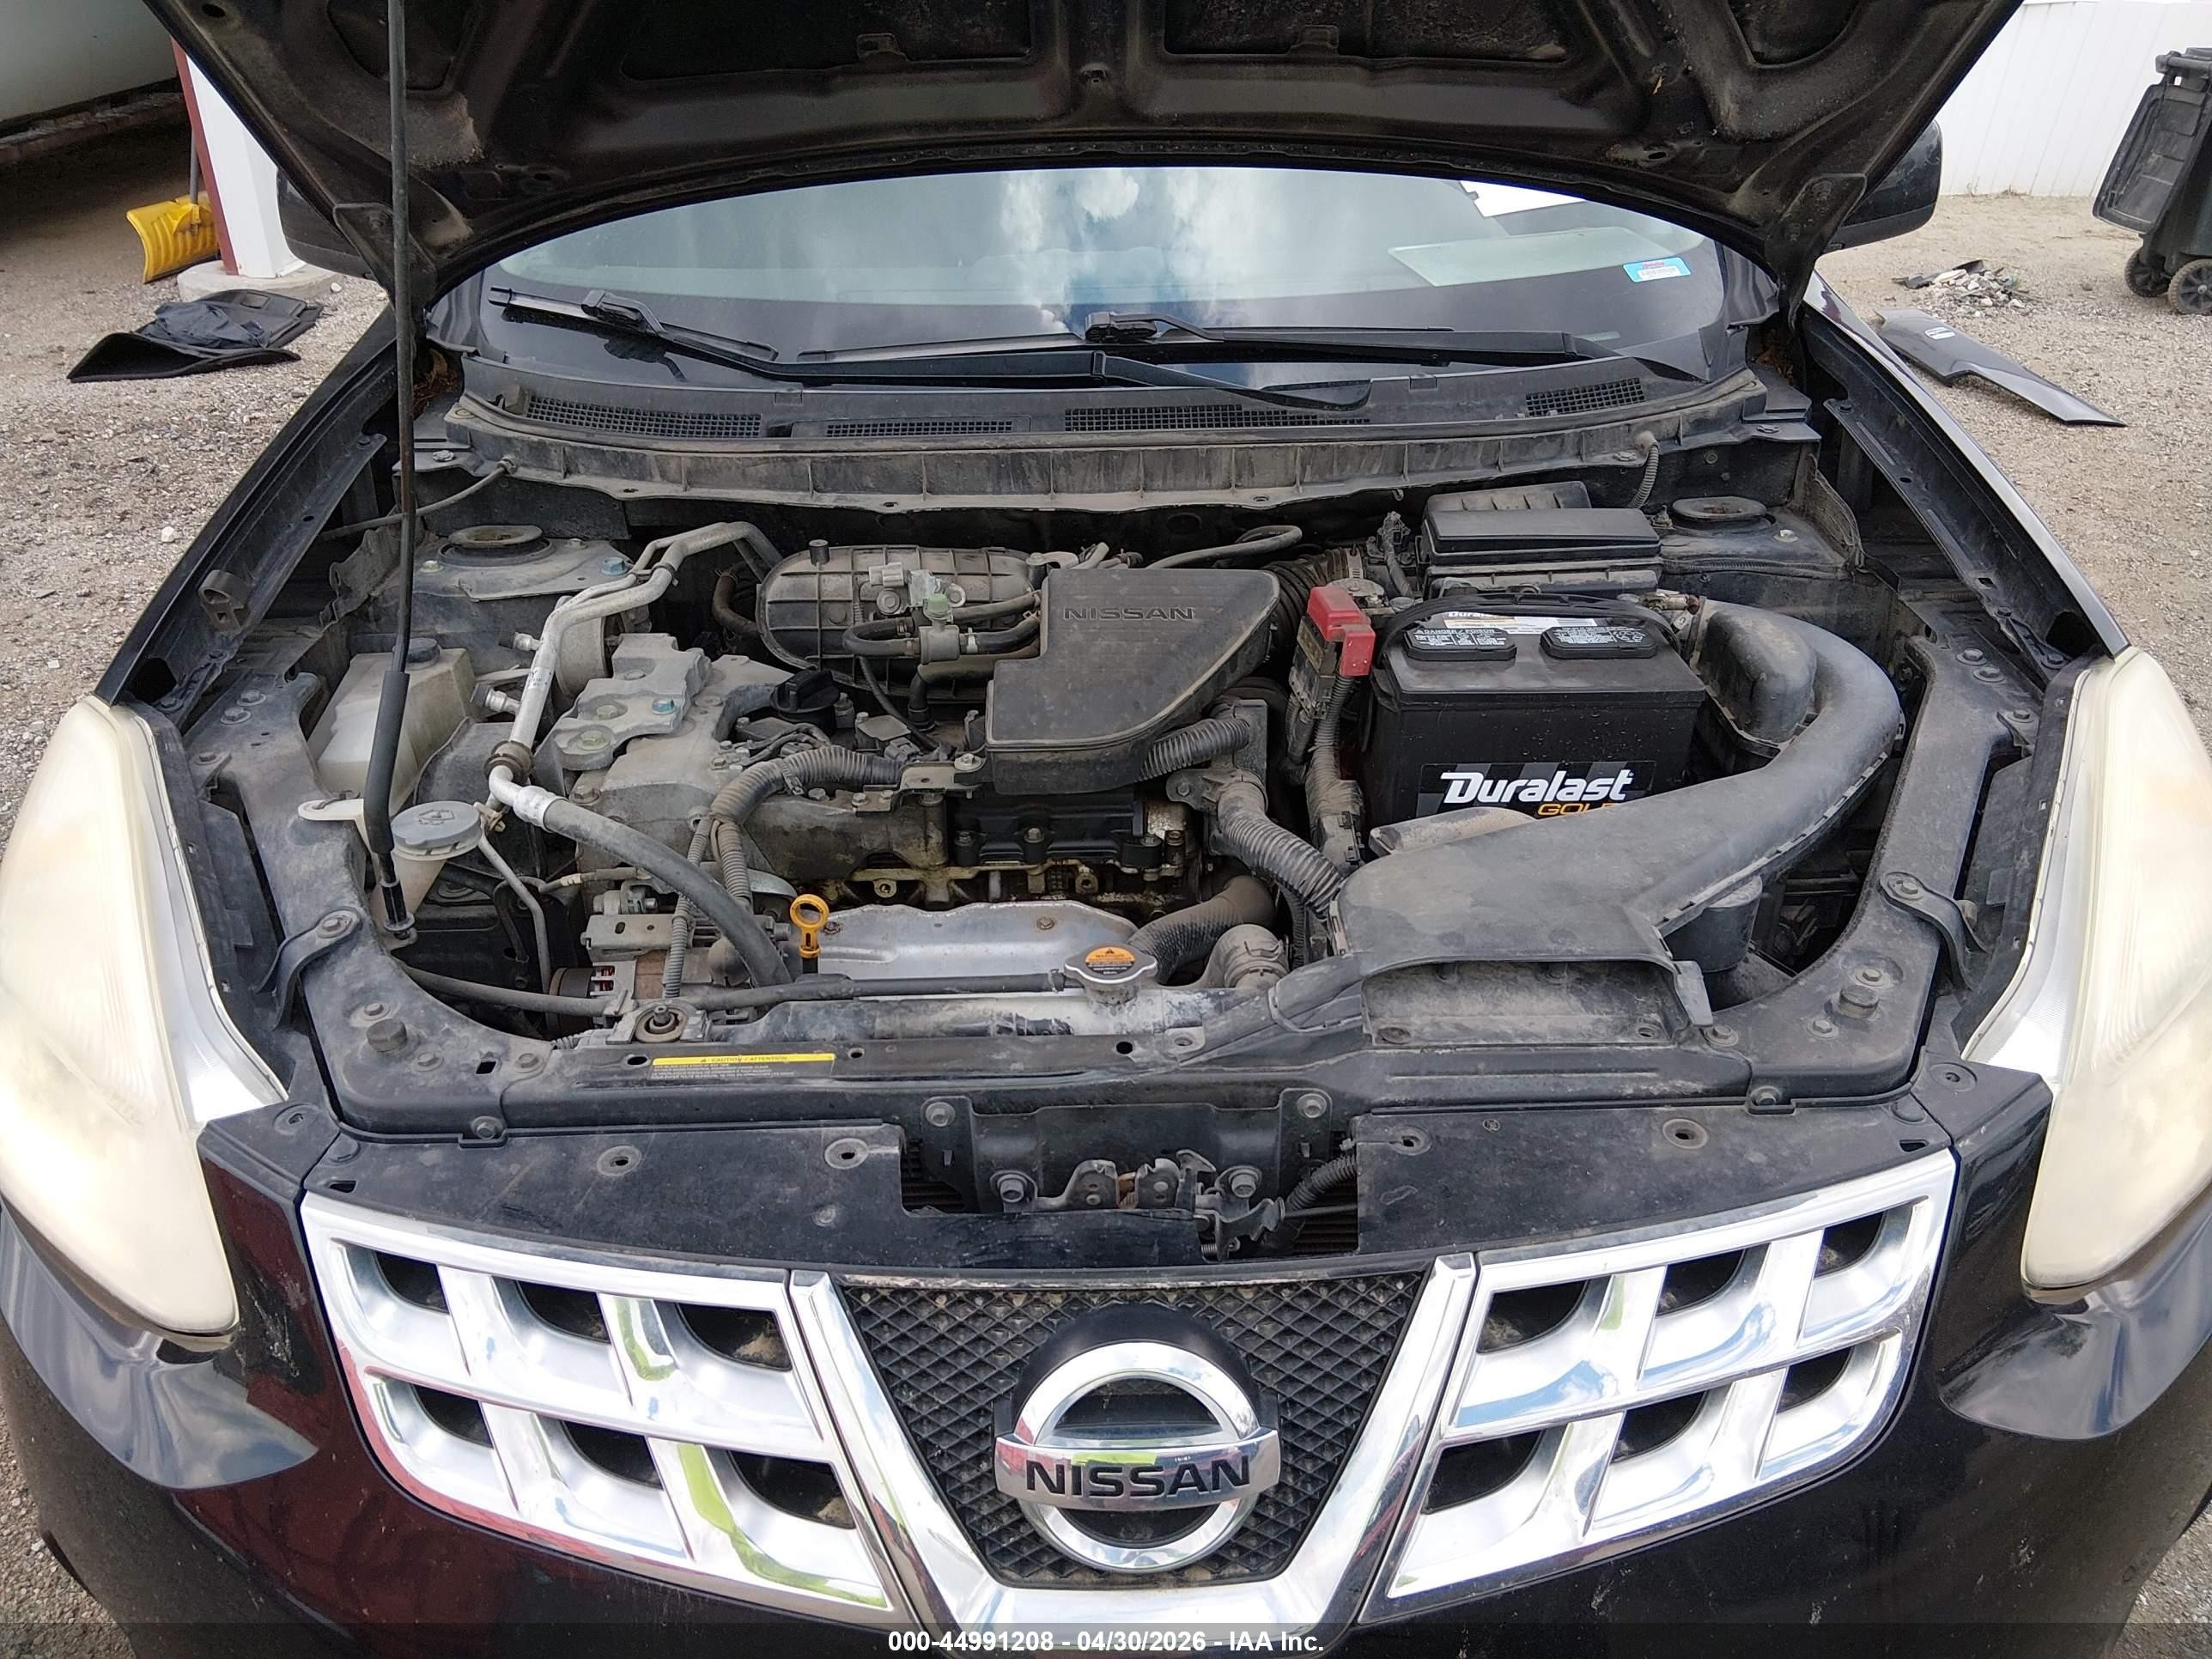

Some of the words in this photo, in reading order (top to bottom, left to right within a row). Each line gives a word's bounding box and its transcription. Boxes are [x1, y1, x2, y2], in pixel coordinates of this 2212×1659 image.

[1063, 606, 1194, 621] NISSAN
[1440, 769, 1634, 804] Duralast
[1026, 1455, 1250, 1498] NISSAN
